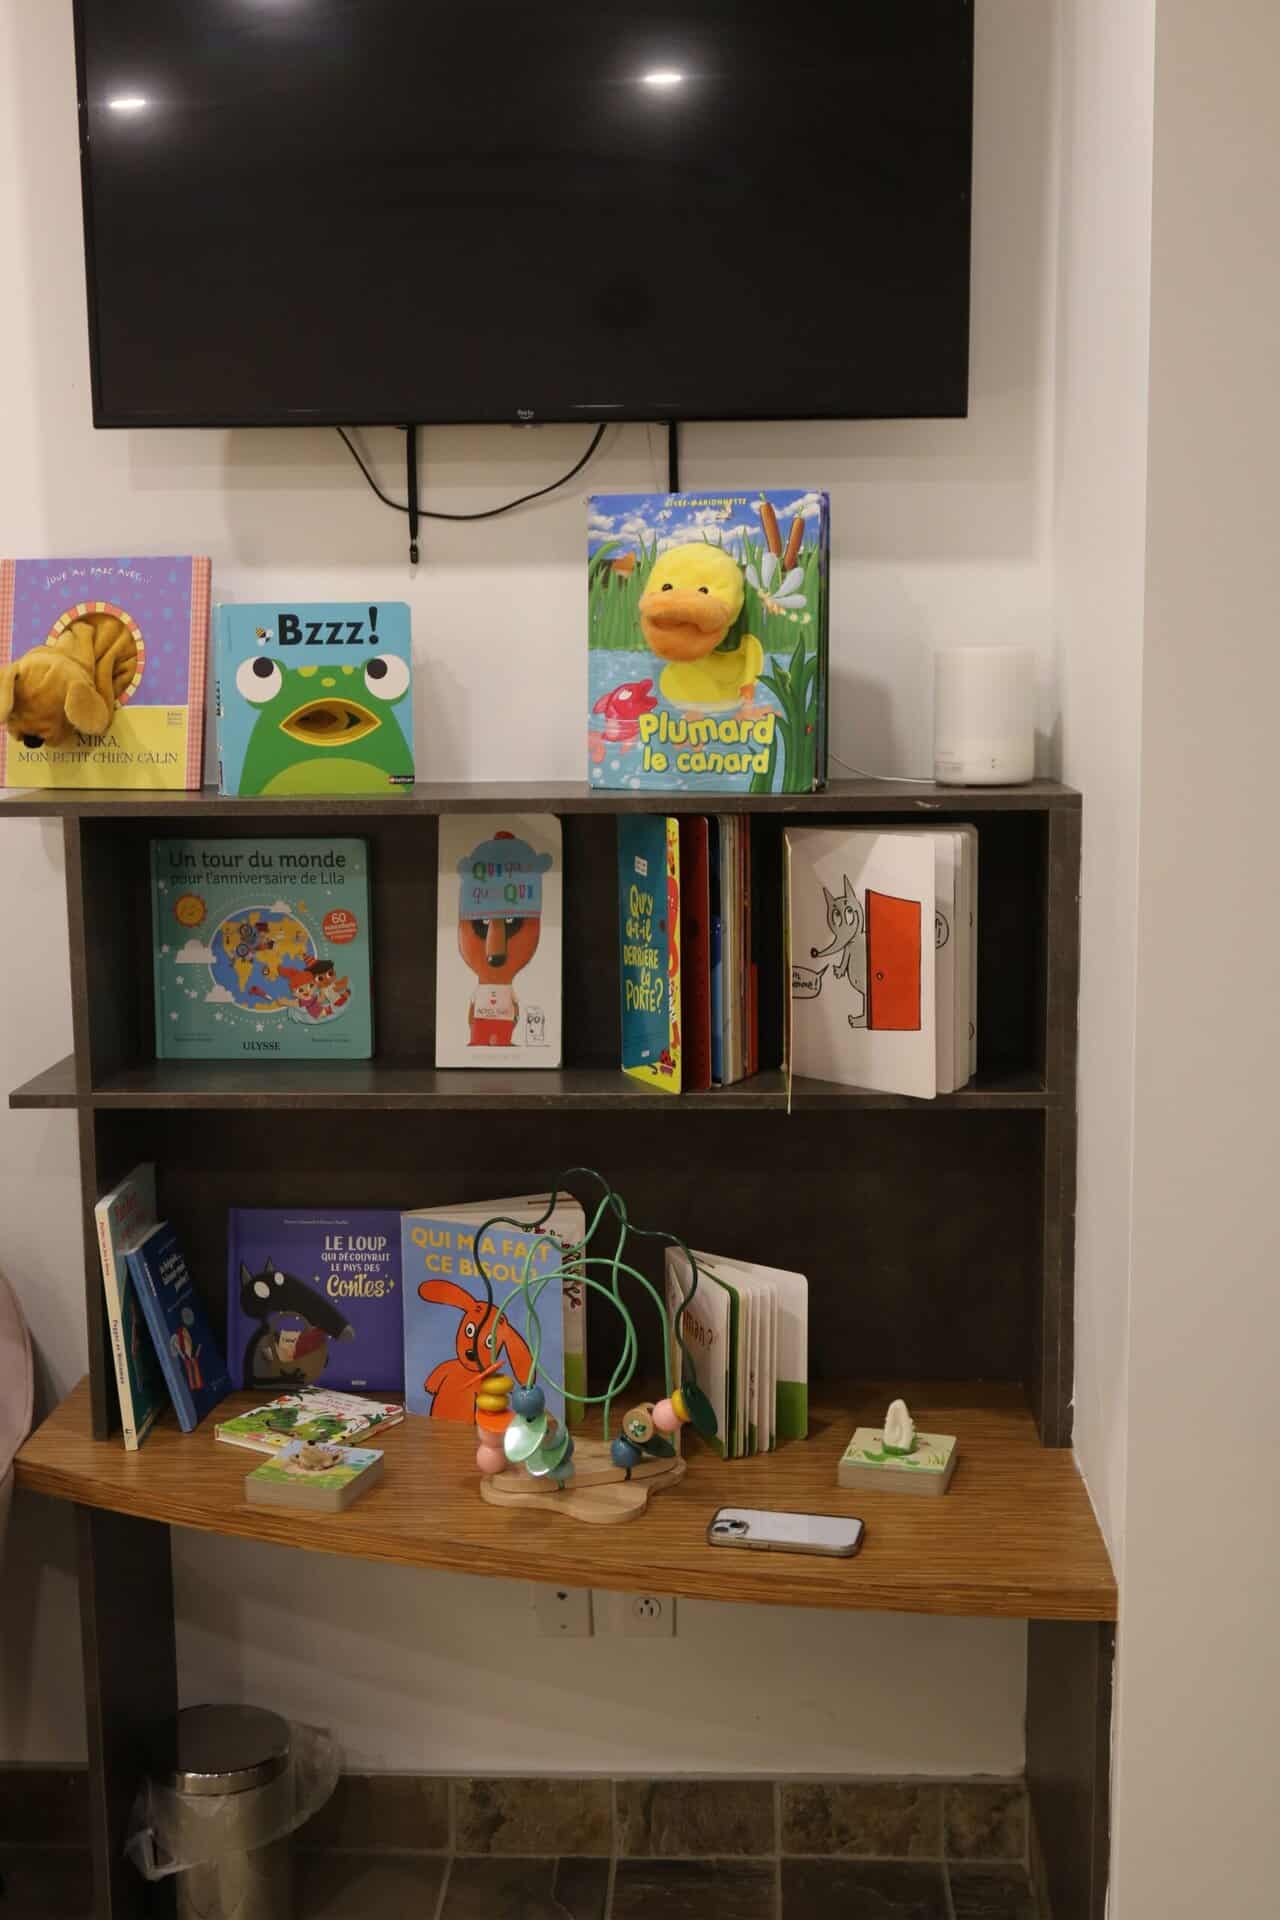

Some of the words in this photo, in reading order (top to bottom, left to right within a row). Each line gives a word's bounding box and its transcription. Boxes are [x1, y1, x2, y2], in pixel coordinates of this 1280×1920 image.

[278, 606, 380, 645] Bzzz!
[638, 711, 776, 746] Plumard
[18, 752, 49, 763] MON
[53, 751, 90, 763] PETIT
[93, 751, 134, 764] CHIEN
[643, 747, 666, 772] le
[676, 748, 770, 774] canard
[169, 851, 197, 868] Un
[201, 853, 243, 868] tour
[248, 850, 273, 868] du
[279, 850, 346, 868] monde
[170, 873, 203, 886] pour
[206, 871, 297, 885] l'anniversaire
[300, 871, 317, 885] de
[321, 871, 345, 885] Lila
[626, 978, 663, 1013] PORTE?
[242, 1040, 281, 1050] ULYSSE
[325, 1236, 344, 1250] LE
[348, 1236, 387, 1251] LOUP
[411, 1227, 451, 1249] QUI
[457, 1233, 497, 1256] MA
[502, 1239, 550, 1263] FAT
[321, 1252, 336, 1262] QUI
[424, 1253, 453, 1274] CE
[331, 1263, 340, 1272] LE
[343, 1263, 362, 1272] PAYS
[364, 1263, 381, 1272] DES
[326, 1273, 385, 1297] Contes
